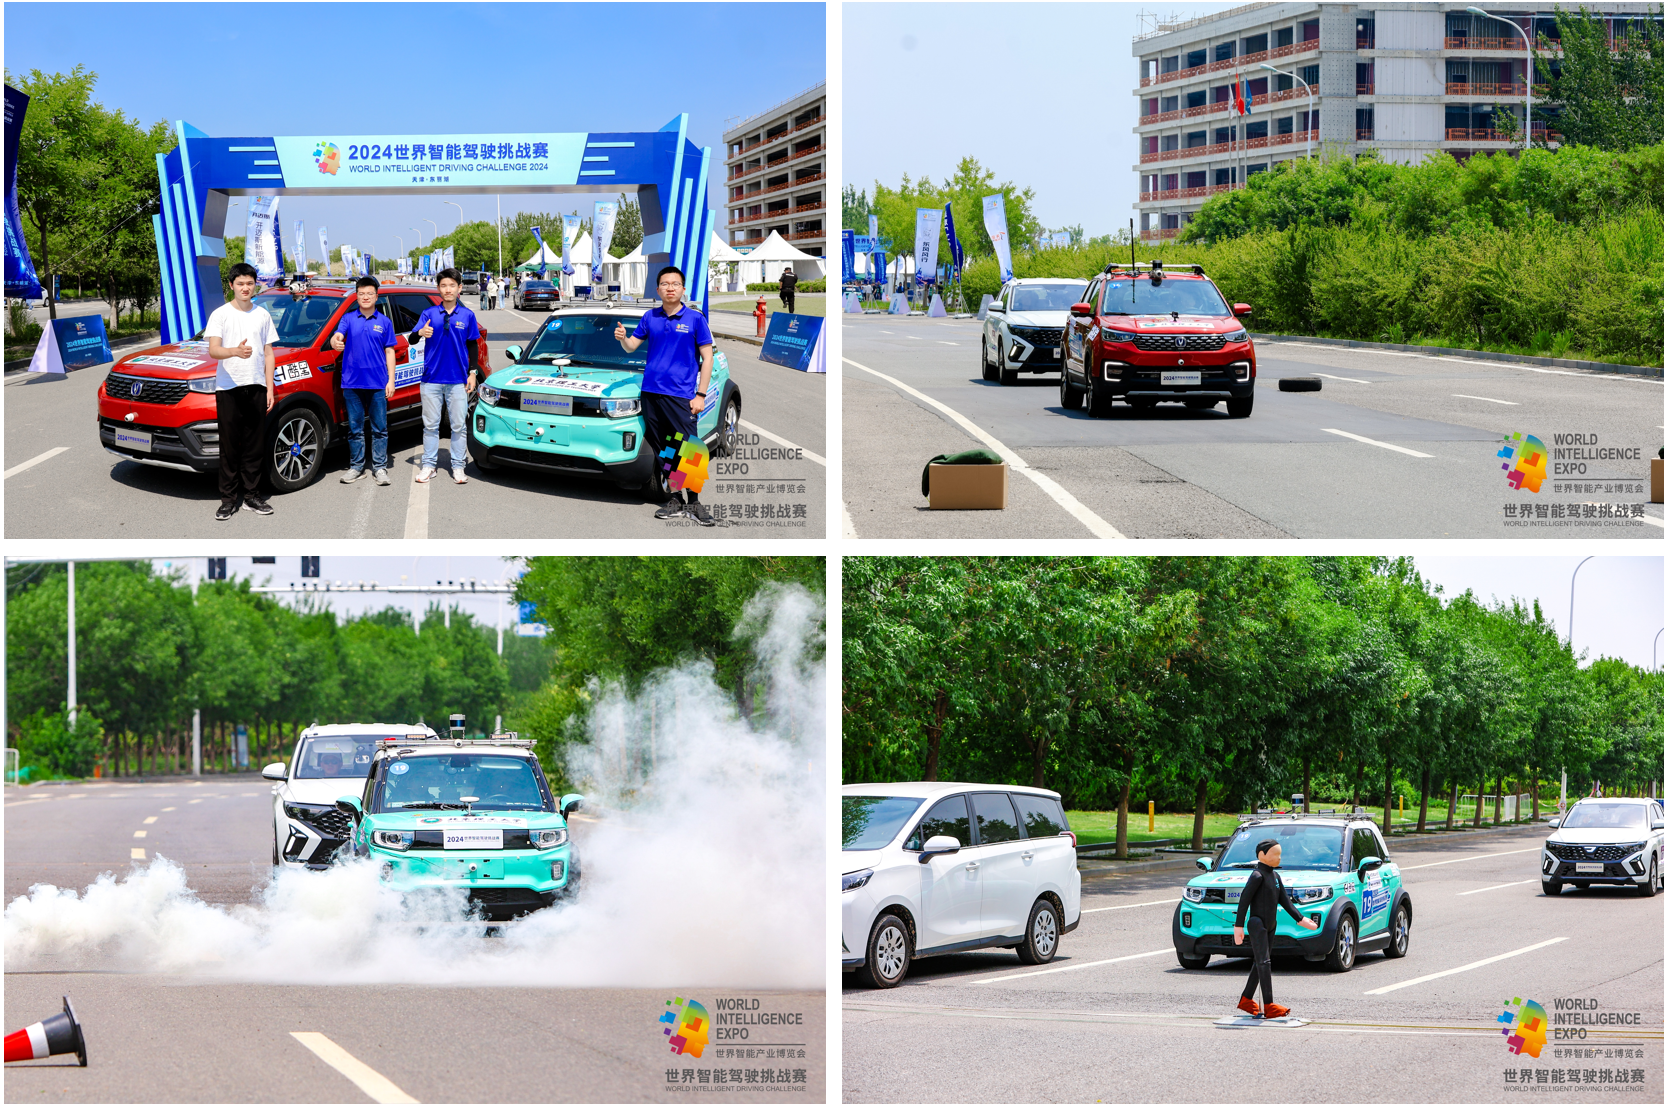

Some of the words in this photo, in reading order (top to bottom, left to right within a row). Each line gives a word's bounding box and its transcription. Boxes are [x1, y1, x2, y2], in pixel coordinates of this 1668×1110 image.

[348, 142, 549, 161] 2024世界智能驾驶挑战赛
[349, 165, 381, 173] WORLD
[383, 164, 437, 173] INTELLIGENT
[439, 163, 474, 172] DRIVING
[476, 163, 528, 172] CHALLENGE
[530, 163, 549, 171] 2024
[254, 221, 265, 265] 开迈斯新能源
[921, 241, 930, 263] 东风风行
[394, 764, 407, 772] 19
[1363, 895, 1372, 914] 19
